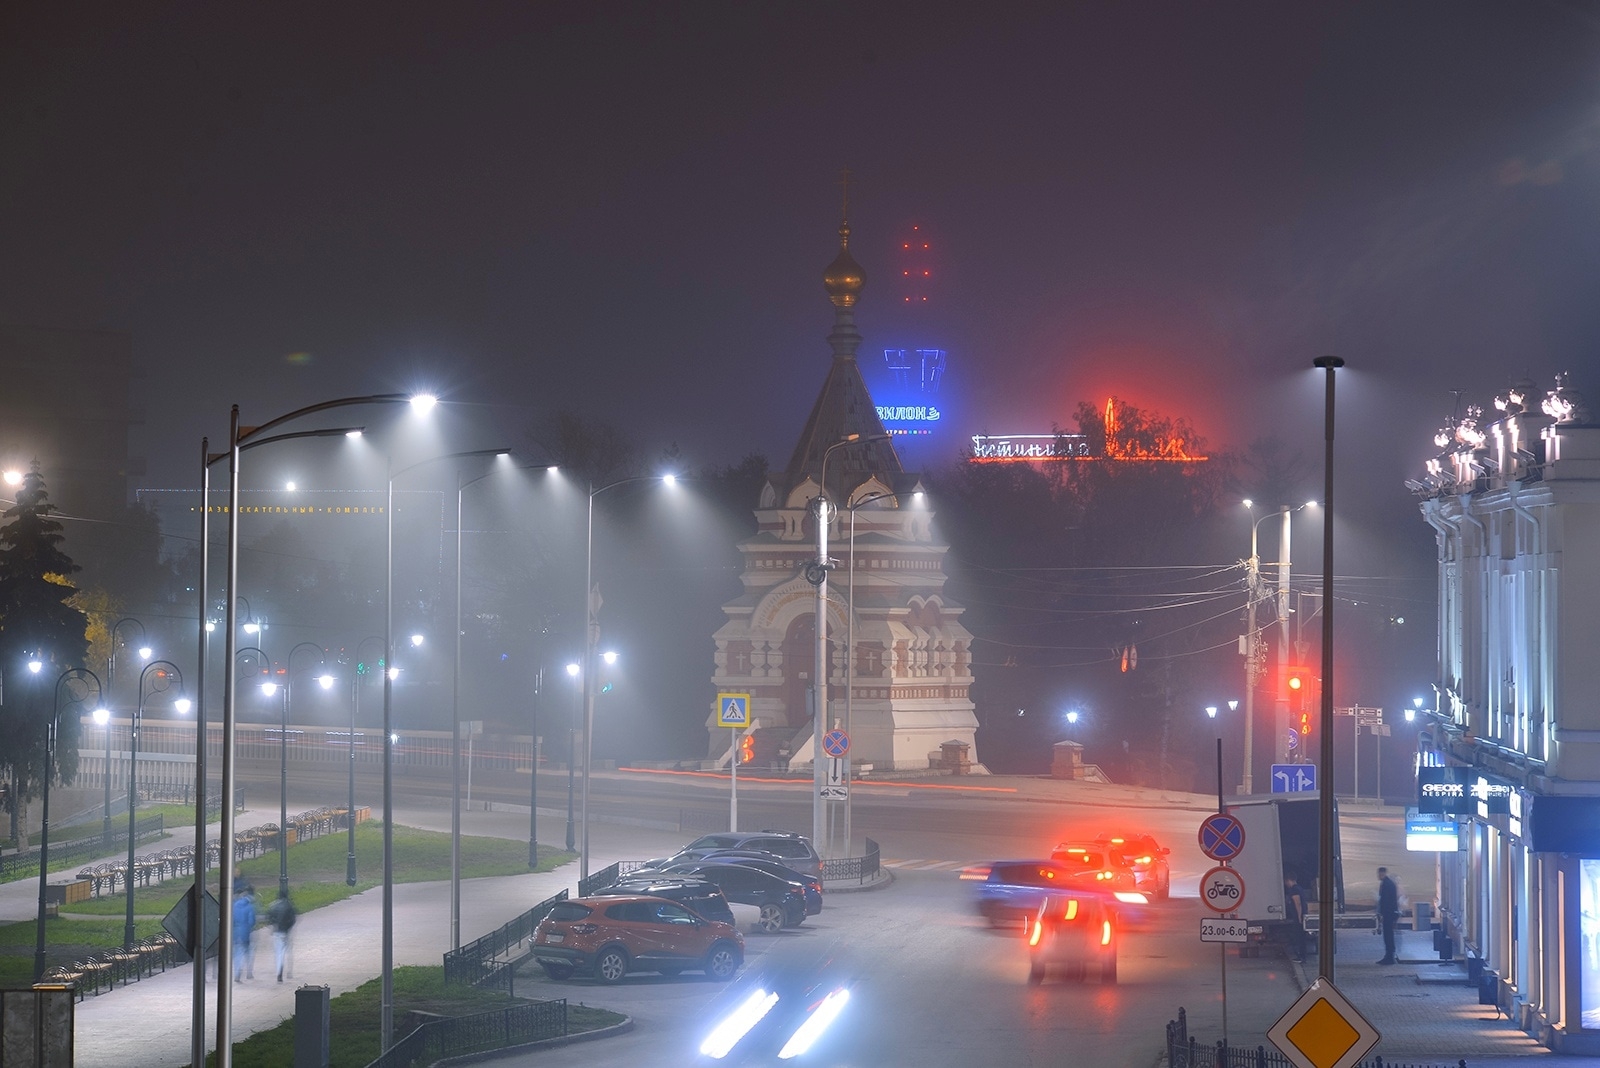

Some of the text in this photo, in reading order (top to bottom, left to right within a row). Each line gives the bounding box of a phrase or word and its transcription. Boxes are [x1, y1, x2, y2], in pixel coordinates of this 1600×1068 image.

[200, 506, 386, 514] АЗВЕКАТЕЛЬНЫЙ КОМПЛЕК
[1422, 784, 1463, 792] GEOX
[1202, 925, 1247, 936] 23.00-6.00
